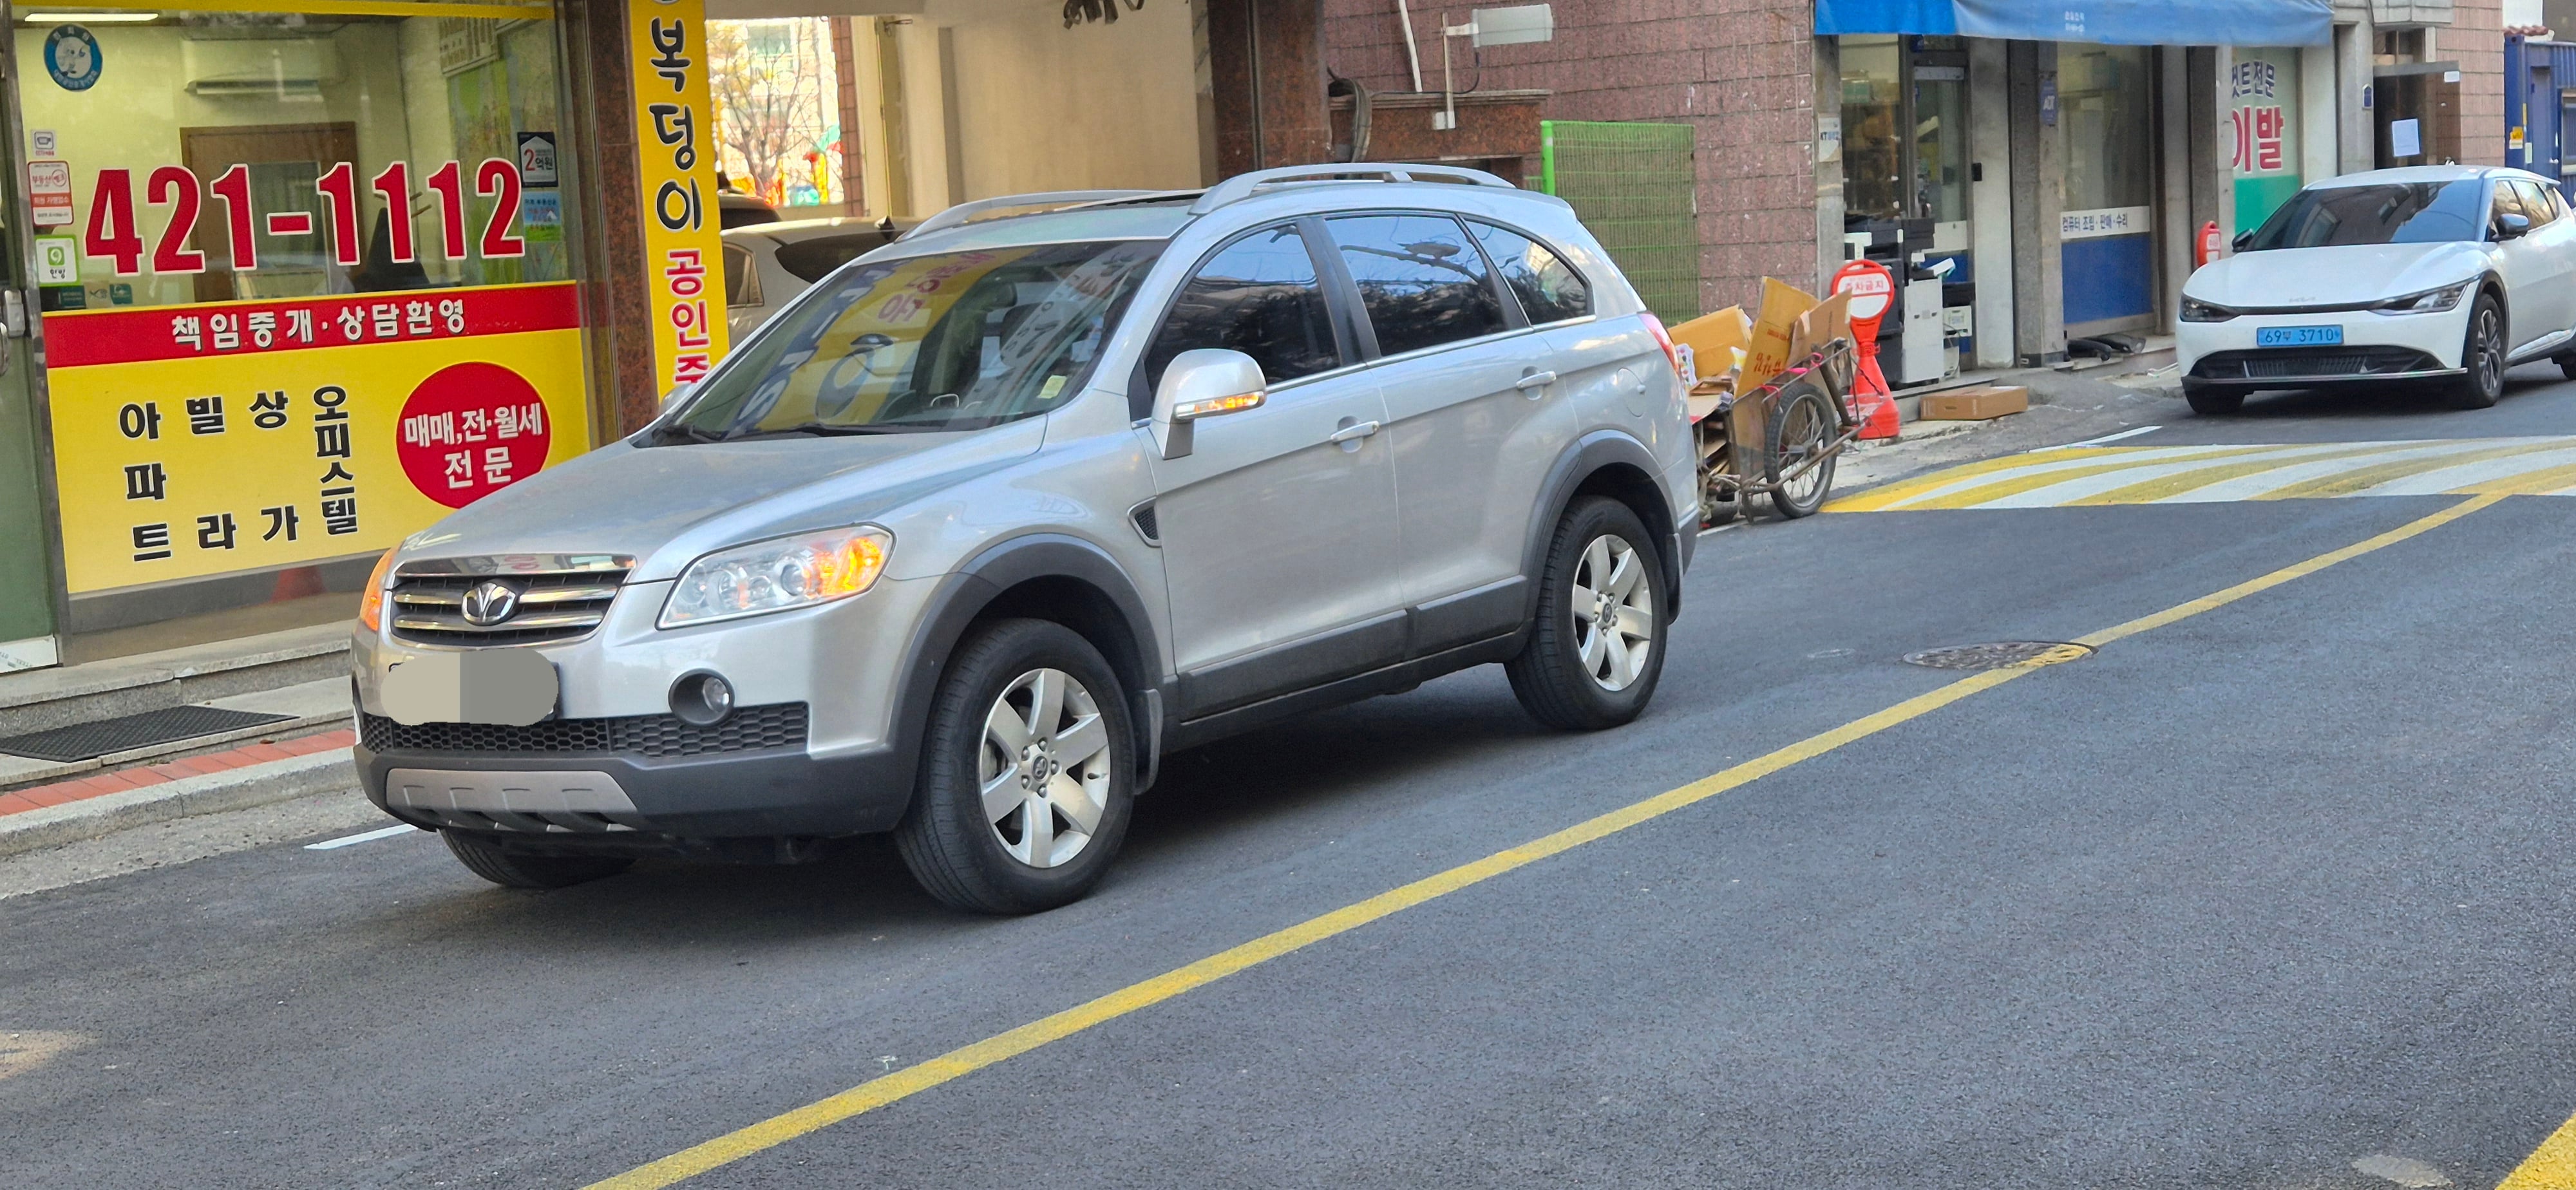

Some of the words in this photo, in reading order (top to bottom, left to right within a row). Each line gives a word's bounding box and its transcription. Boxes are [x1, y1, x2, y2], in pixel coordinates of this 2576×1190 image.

[650, 16, 702, 231] 복덩이
[86, 157, 525, 276] 421-1112
[2299, 328, 2334, 343] 3710
[119, 401, 172, 562] 아파트
[313, 386, 358, 536] 오피스텔
